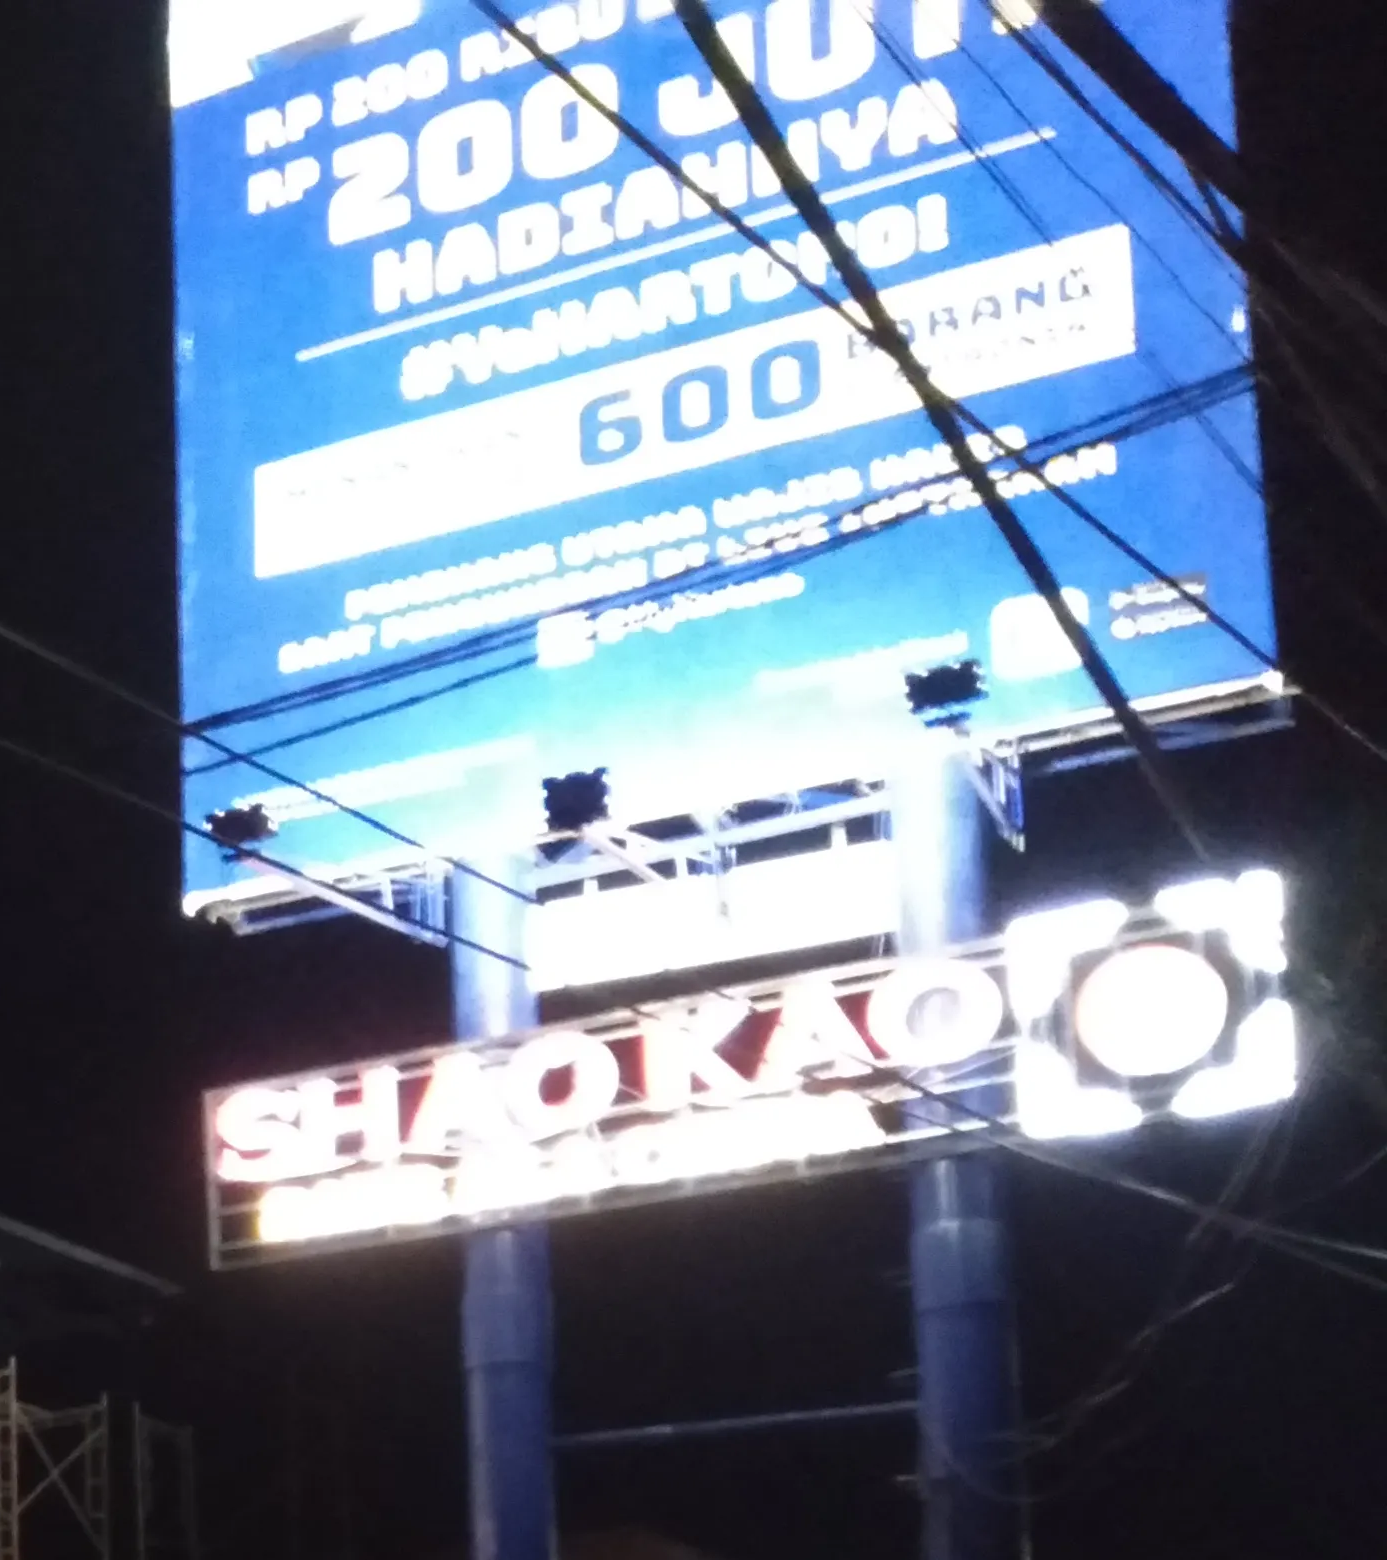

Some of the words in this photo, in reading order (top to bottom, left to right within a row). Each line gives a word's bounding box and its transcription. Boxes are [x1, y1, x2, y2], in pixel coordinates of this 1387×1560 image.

[328, 62, 620, 246] 200
[372, 78, 957, 315] HADIAHNYA
[579, 340, 821, 467] 600
[215, 1029, 621, 1184] SHAO
[637, 958, 1007, 1112] KAO
